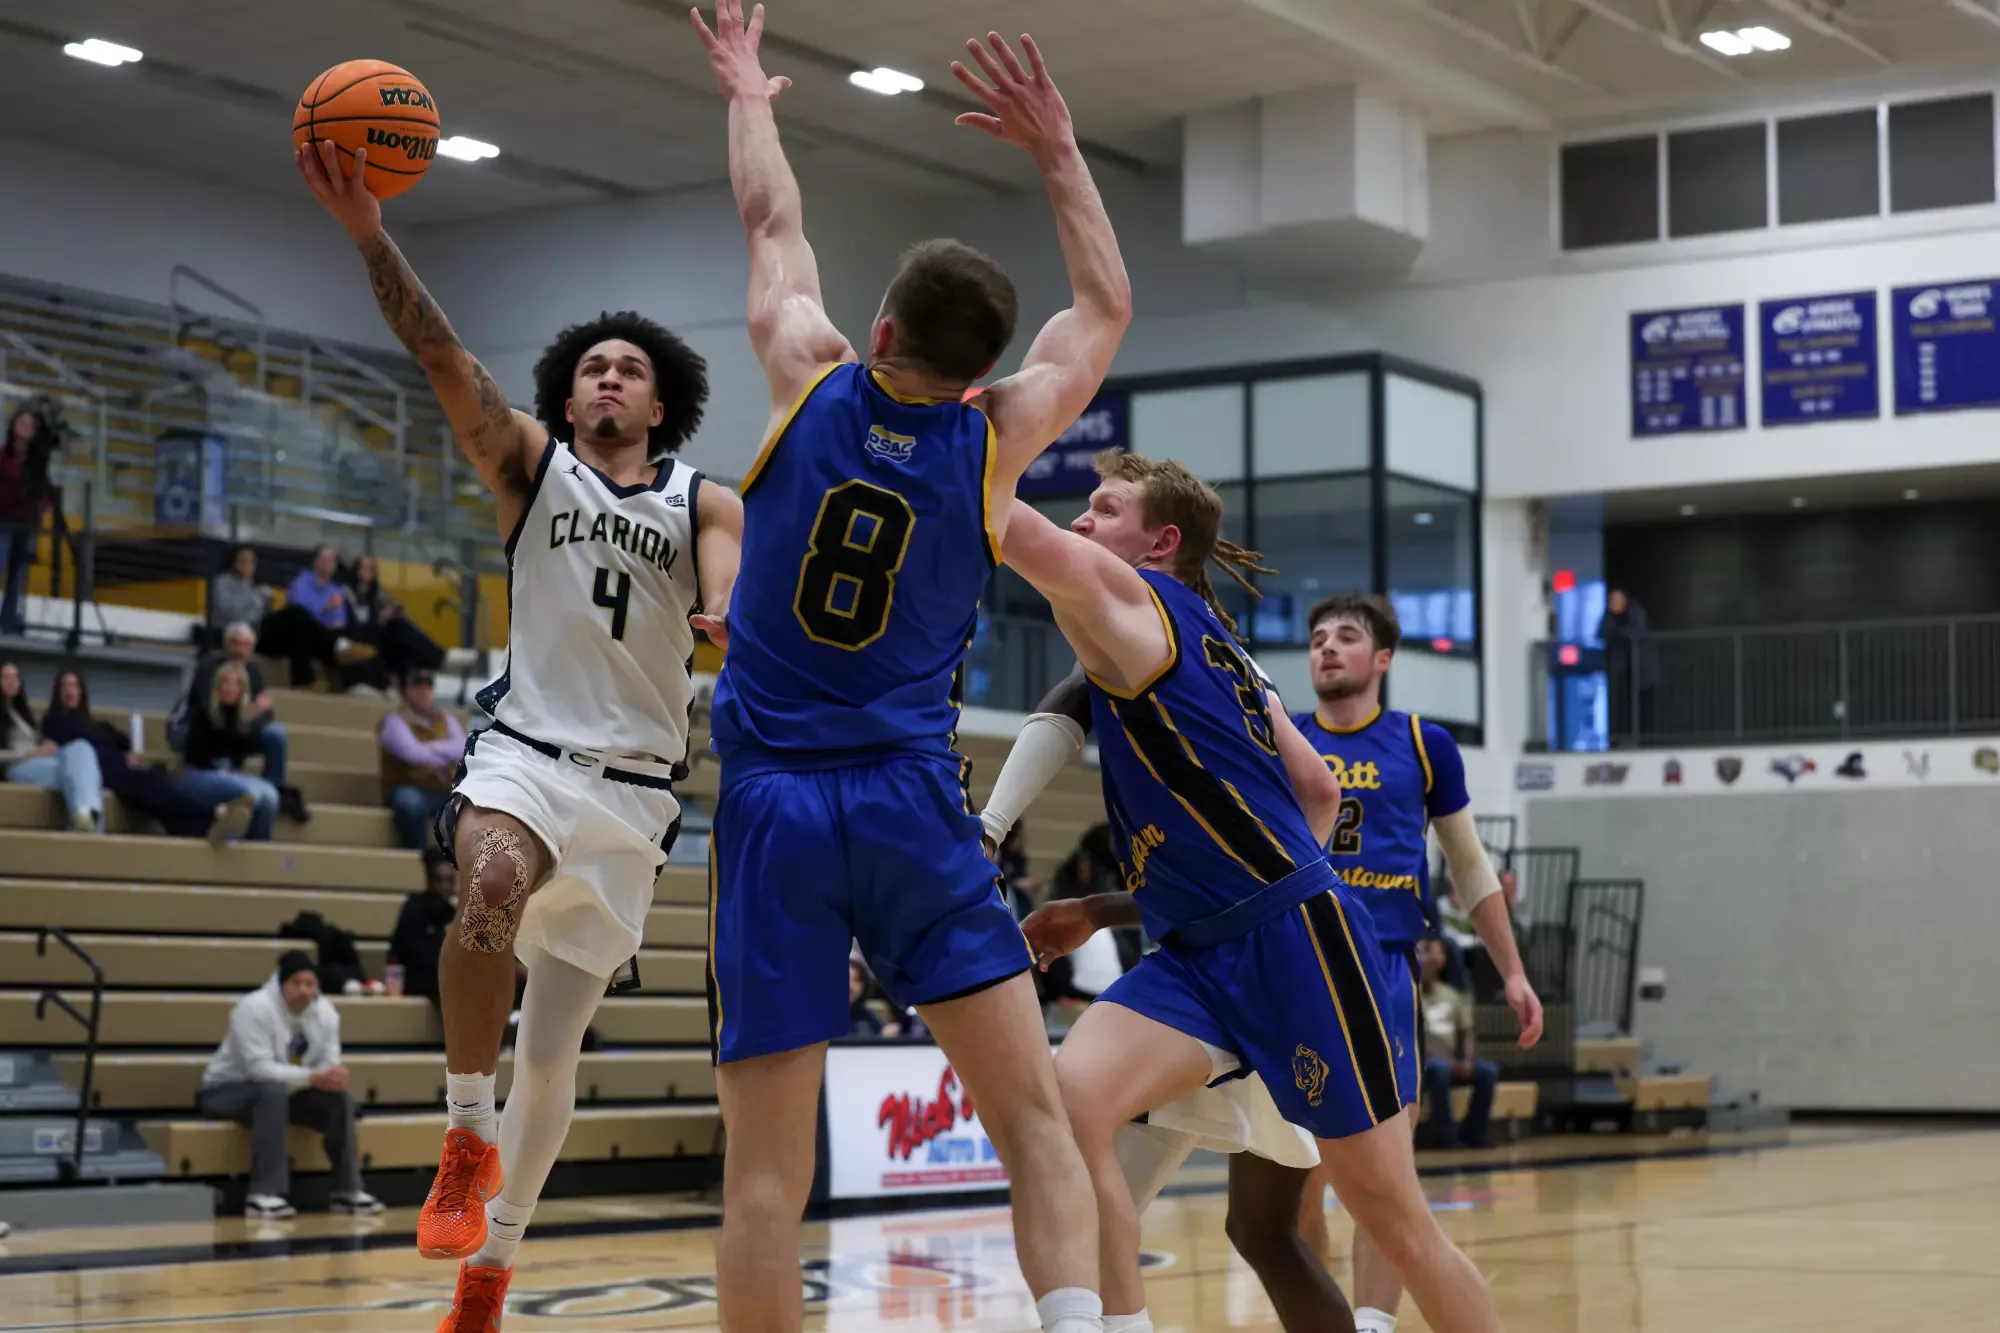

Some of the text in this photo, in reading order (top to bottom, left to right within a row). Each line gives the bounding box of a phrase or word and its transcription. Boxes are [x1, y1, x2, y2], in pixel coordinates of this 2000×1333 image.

[378, 88, 434, 112] NCAA
[366, 127, 439, 161] Wilson
[869, 432, 912, 455] PSAC
[550, 509, 678, 580] CLARION
[792, 478, 916, 652] 8
[593, 567, 631, 641] 4
[1320, 754, 1382, 790] Pitt
